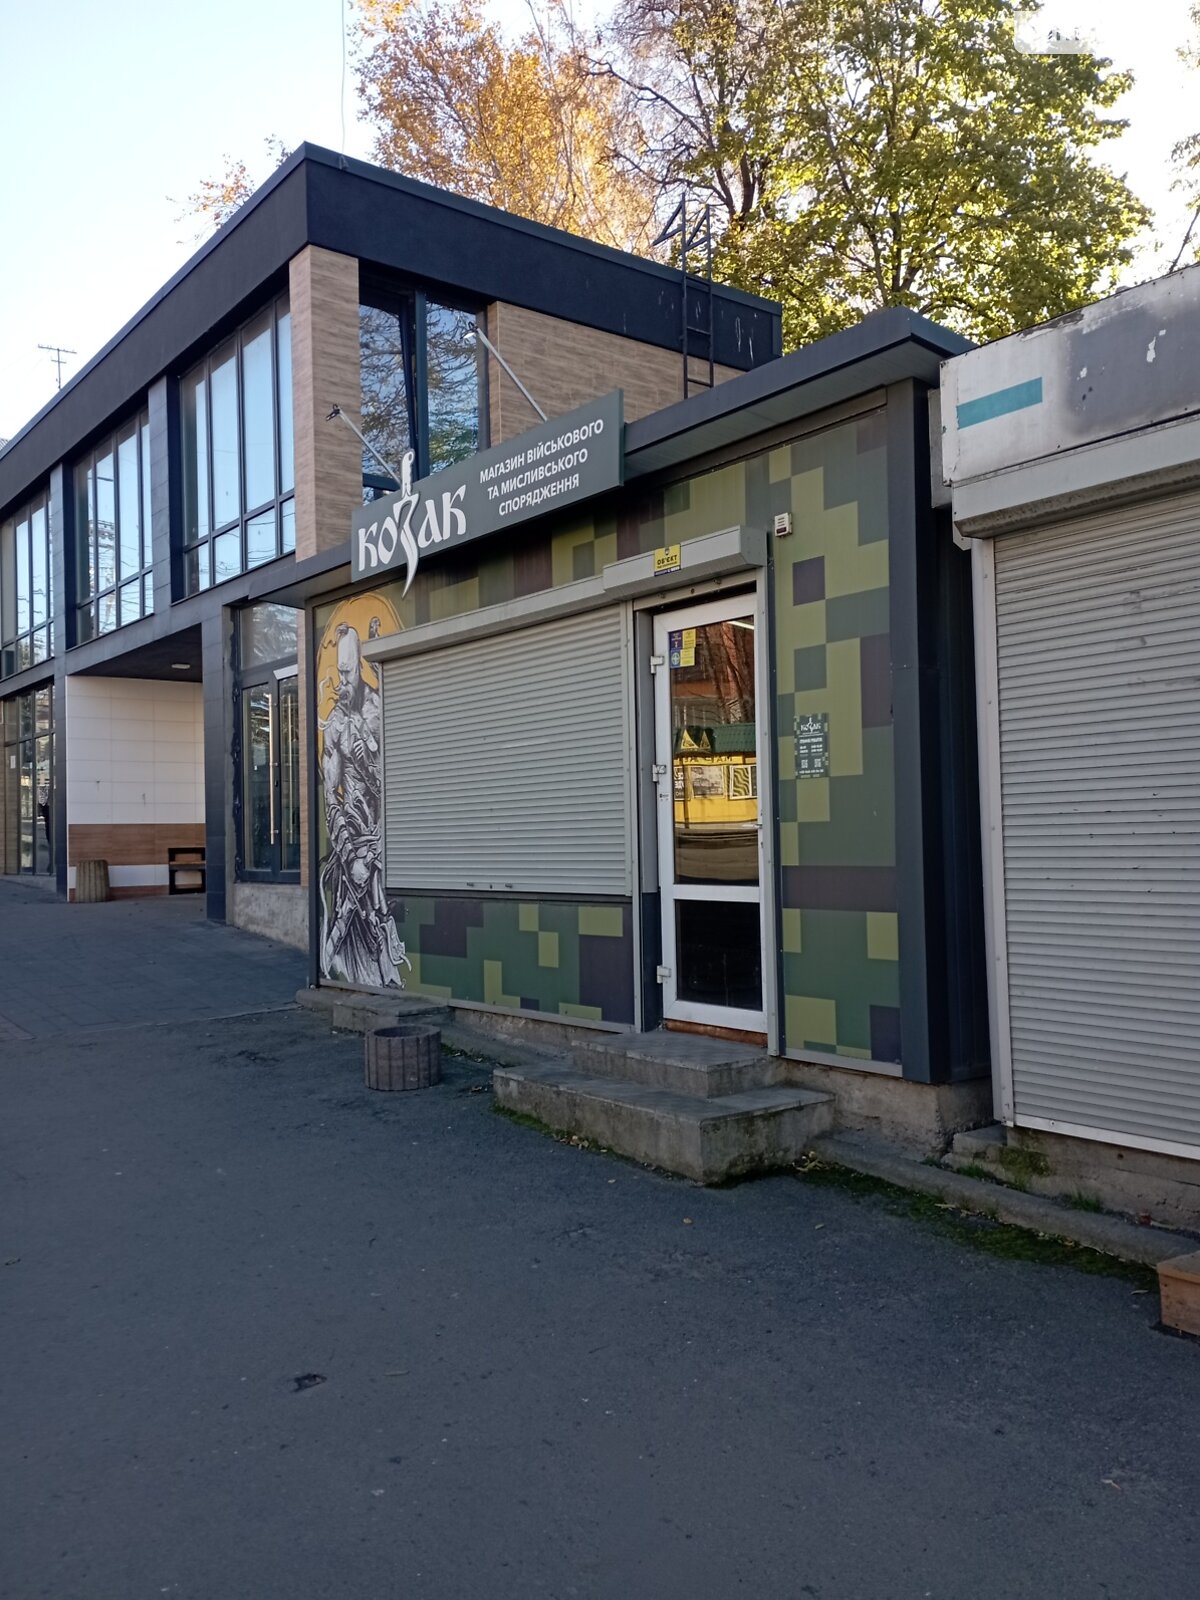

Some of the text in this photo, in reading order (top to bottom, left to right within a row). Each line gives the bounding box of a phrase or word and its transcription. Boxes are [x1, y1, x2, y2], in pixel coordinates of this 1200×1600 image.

[480, 418, 604, 484] МАГАЗИН ВІЙСЬКОВОГО
[488, 448, 588, 500] ТА МИСЛИВСЬКОГО
[499, 473, 580, 516] СПОРЯДЖЕННЯ
[358, 451, 467, 599] КОЗАК
